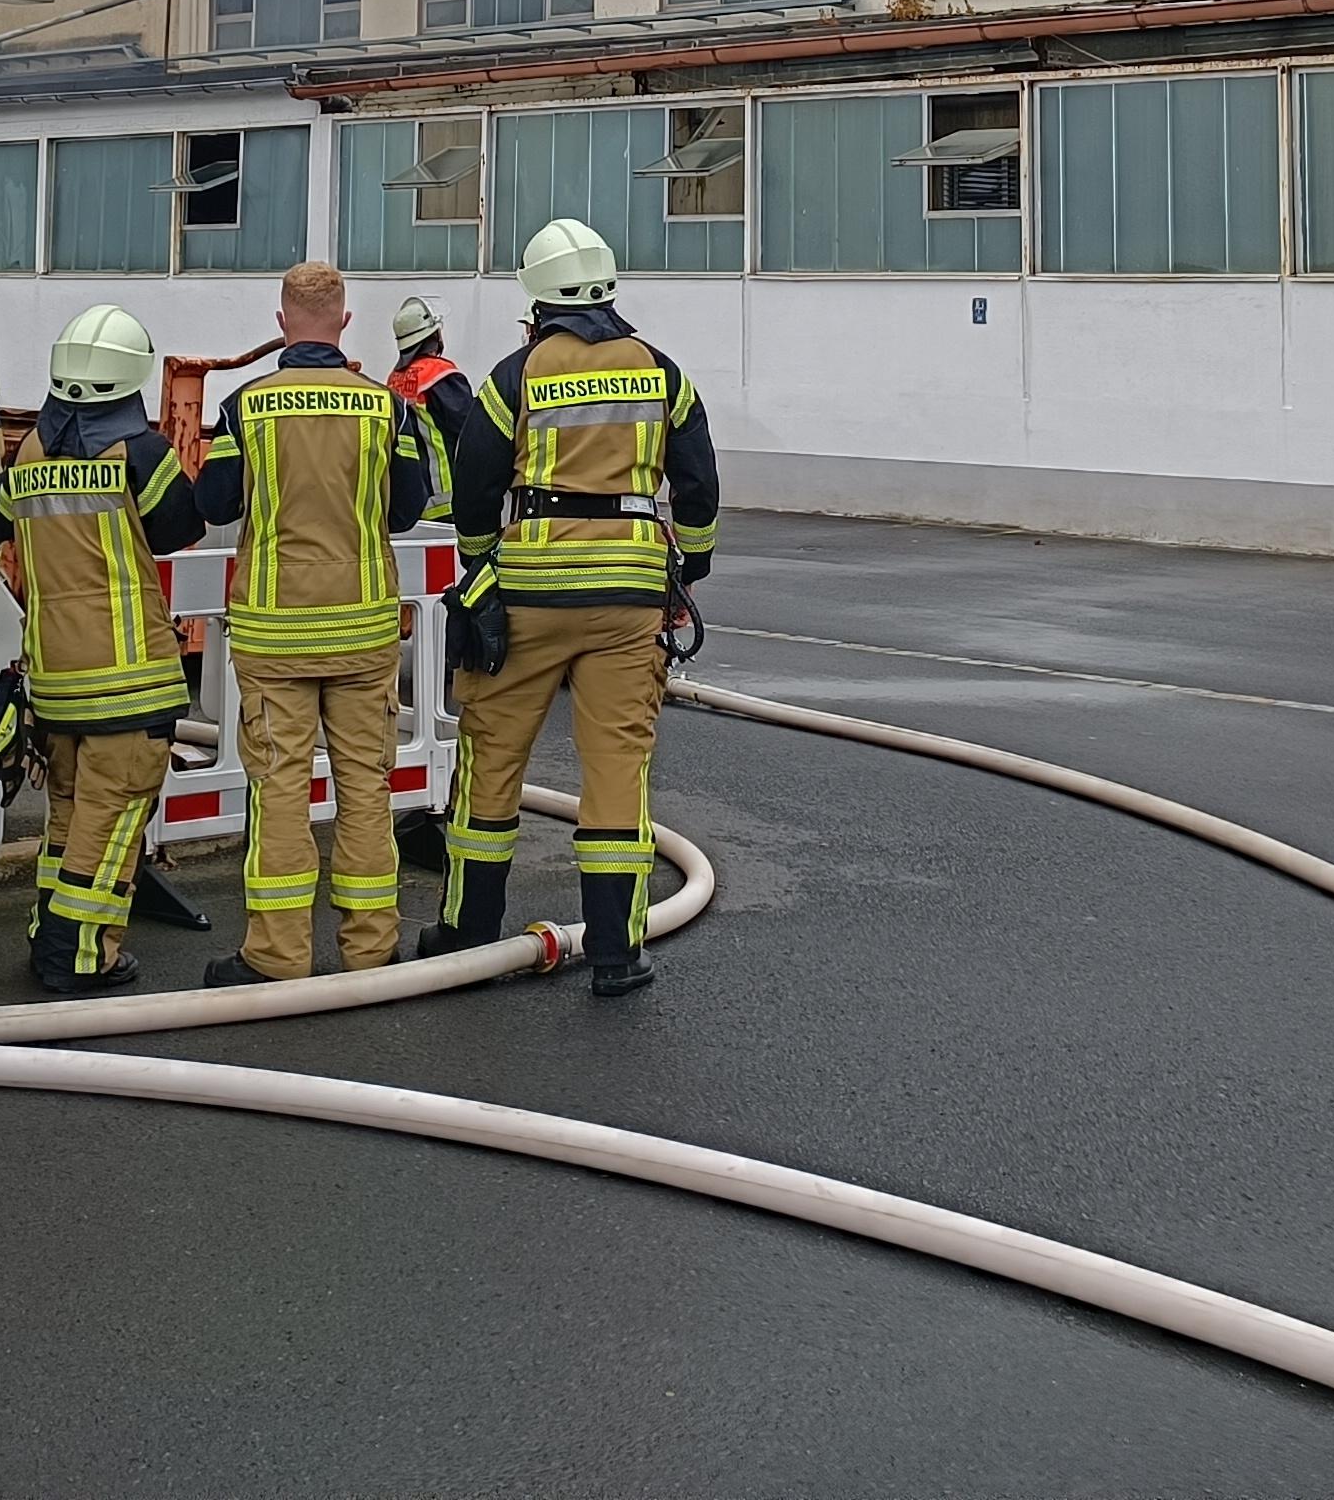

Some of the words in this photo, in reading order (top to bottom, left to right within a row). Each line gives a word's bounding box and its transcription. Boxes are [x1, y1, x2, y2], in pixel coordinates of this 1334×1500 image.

[247, 390, 385, 414] WEISSENSTADT
[530, 376, 661, 403] WEISSENSTADT
[12, 463, 121, 495] WEISSENSTADT
